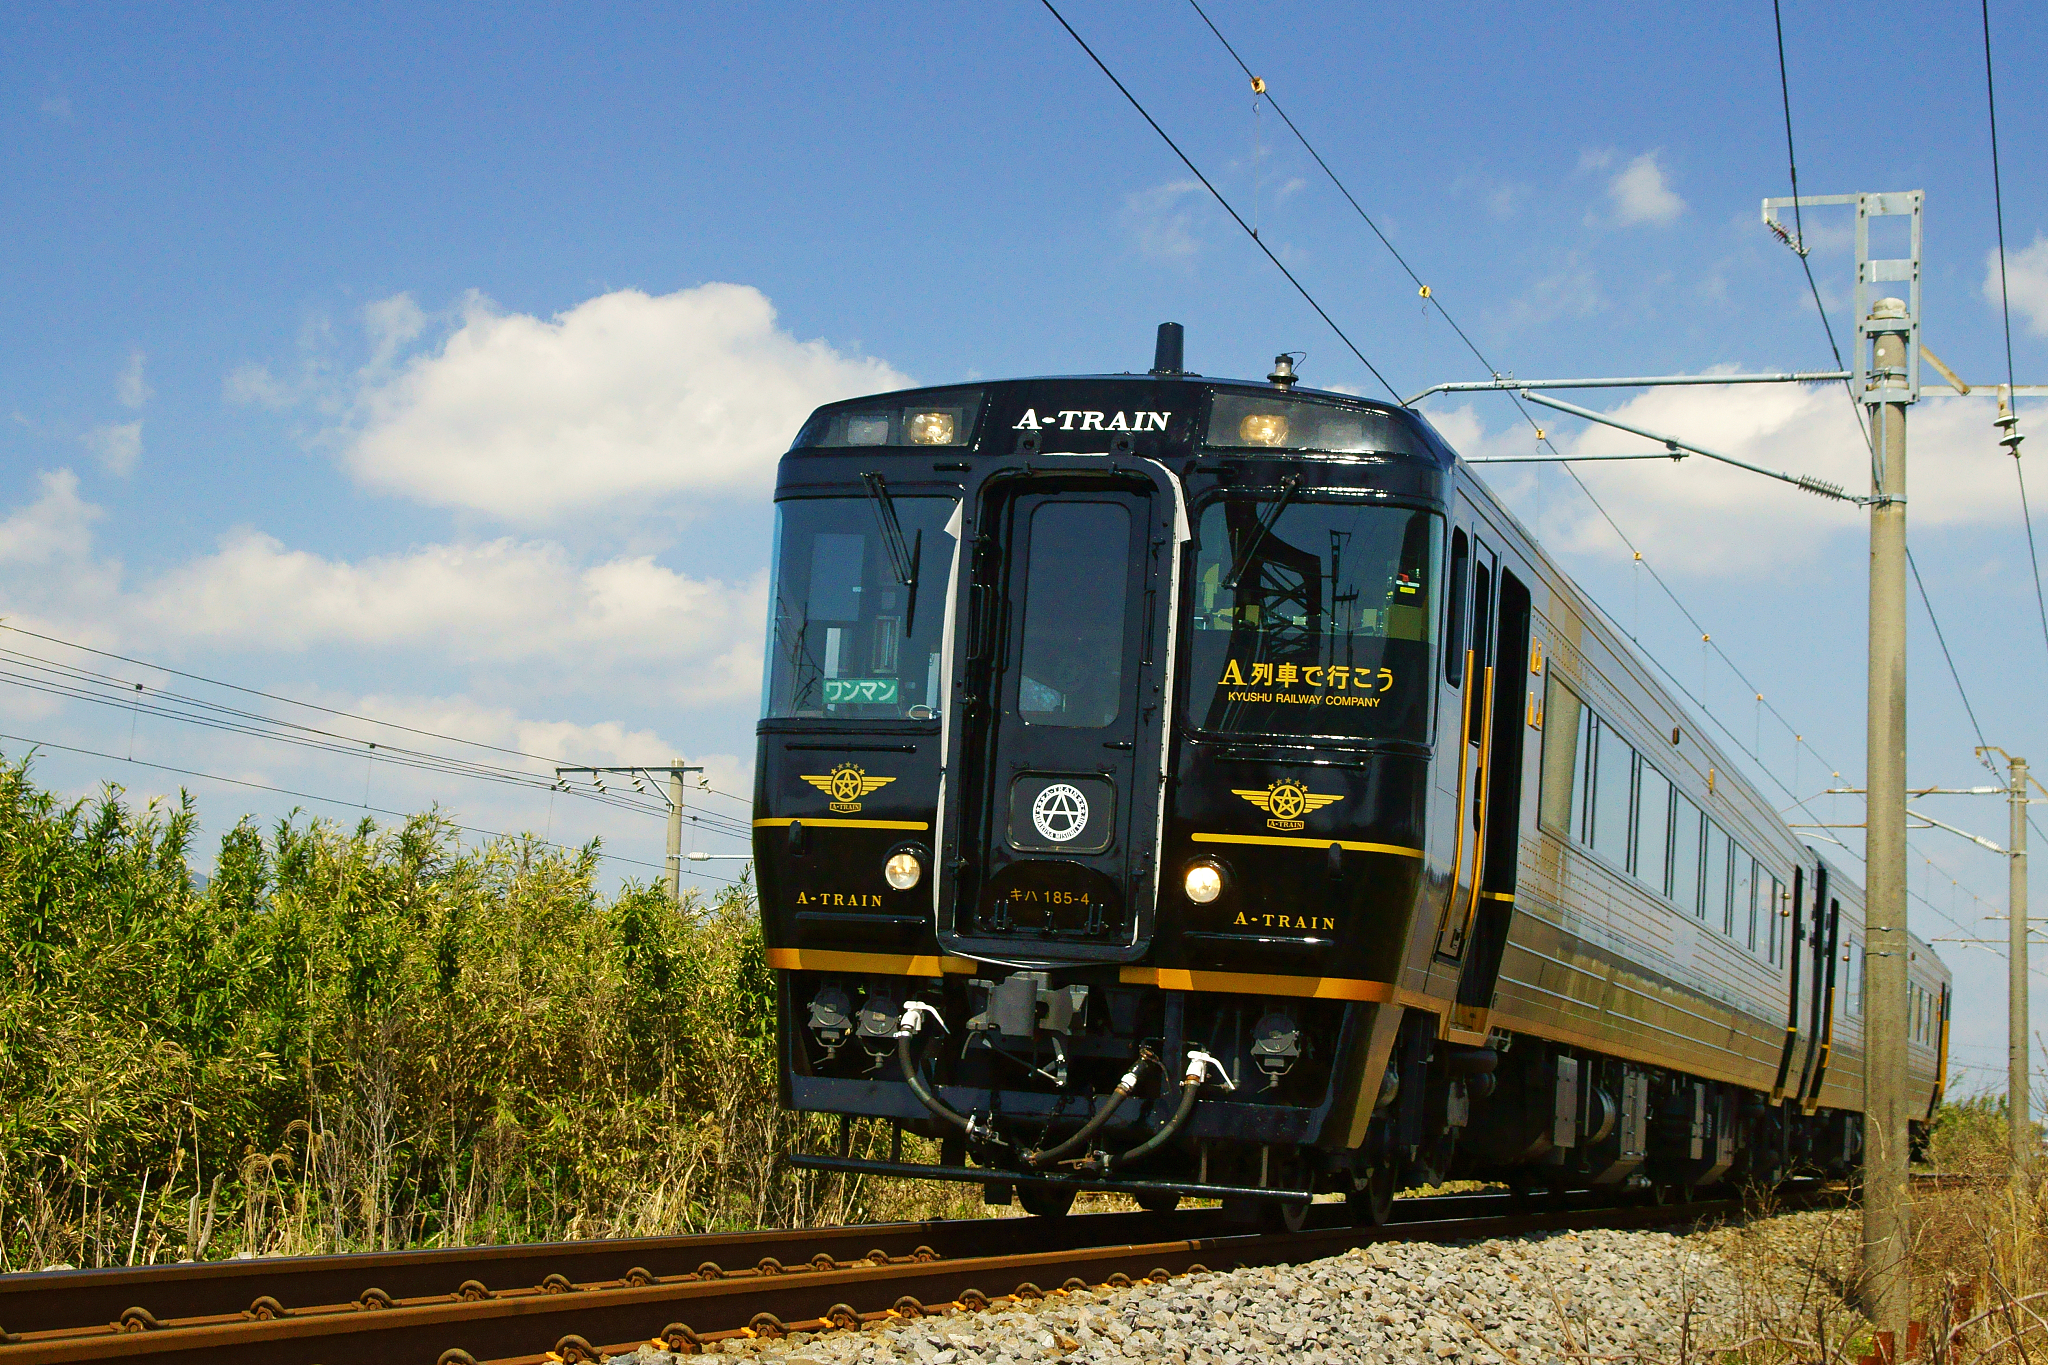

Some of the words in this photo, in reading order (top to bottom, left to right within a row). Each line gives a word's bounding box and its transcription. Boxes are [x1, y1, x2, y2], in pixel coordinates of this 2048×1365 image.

[1012, 408, 1172, 431] A-TRAIN
[825, 682, 896, 701] ワンマン
[1228, 691, 1272, 703] KYUSHU
[1275, 693, 1323, 705] RAILWAY
[1325, 695, 1381, 708] COMPANY
[831, 802, 861, 811] A-TRAIN
[1269, 819, 1303, 829] A-TRAIN
[796, 891, 882, 907] A-TRAIN
[1010, 888, 1038, 902] キハ
[1044, 891, 1090, 905] 185-4
[1233, 911, 1335, 930] A-TRAIN
